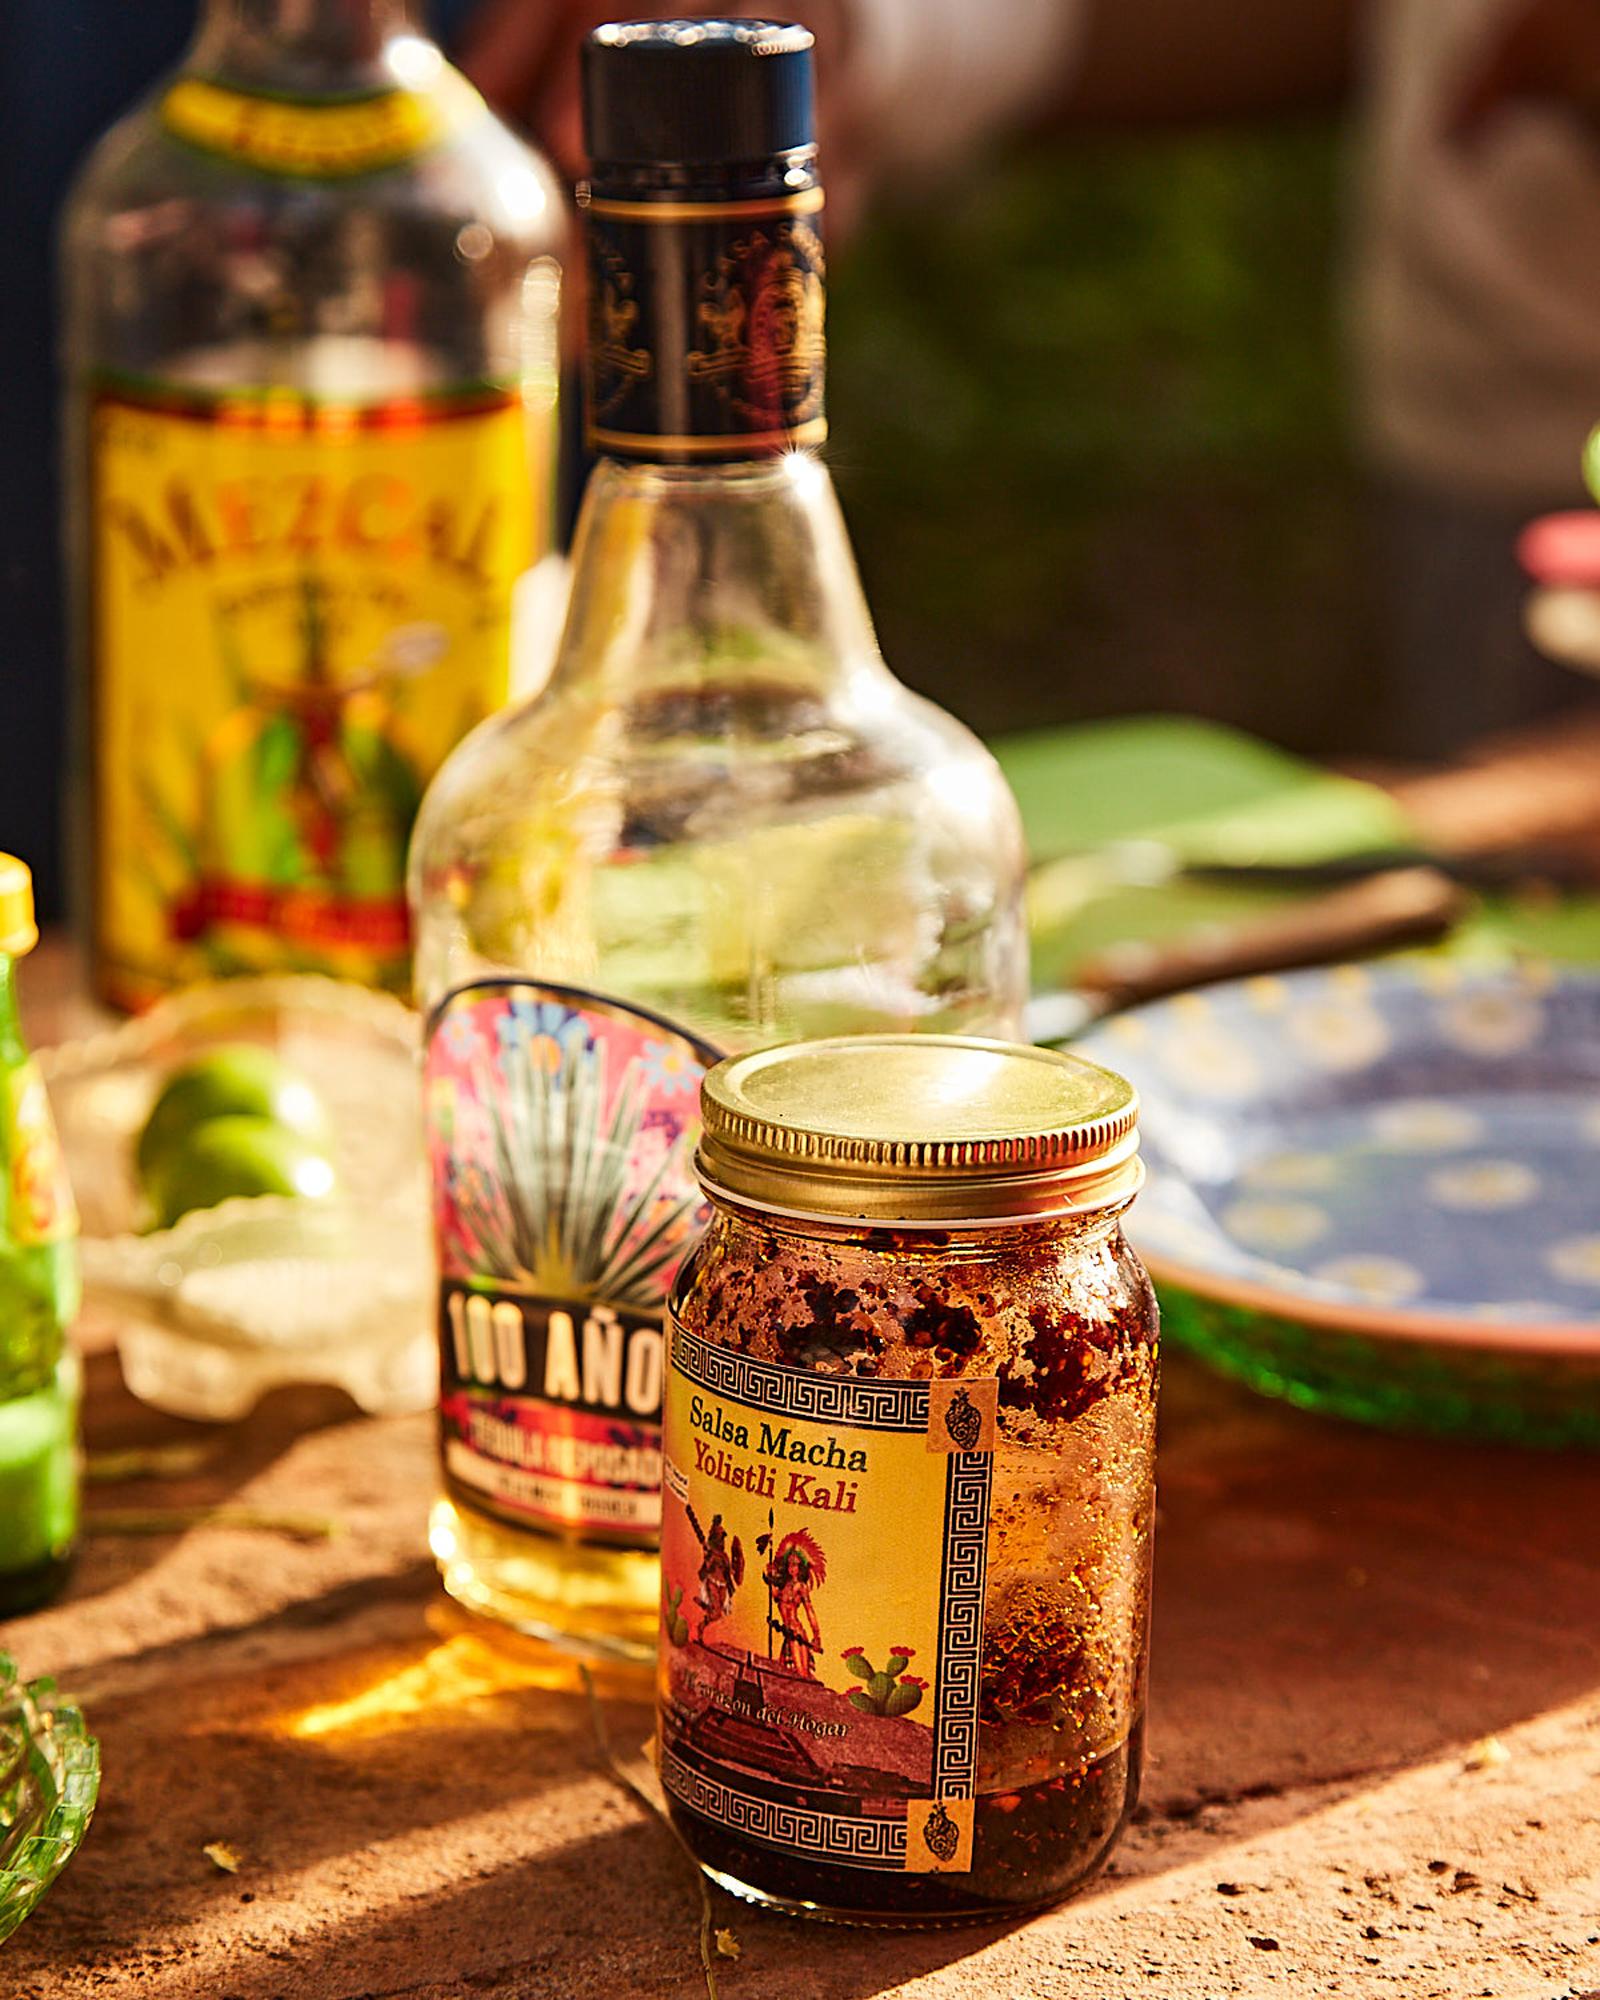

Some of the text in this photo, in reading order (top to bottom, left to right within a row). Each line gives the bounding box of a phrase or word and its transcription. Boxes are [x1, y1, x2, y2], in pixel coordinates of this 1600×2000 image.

[448, 1290, 528, 1391] 100
[689, 1395, 868, 1472] Salsa Macha
[693, 1437, 776, 1498] Yolistli
[786, 1471, 859, 1513] Kali
[755, 1703, 786, 1726] del
[787, 1710, 852, 1741] Hogar
